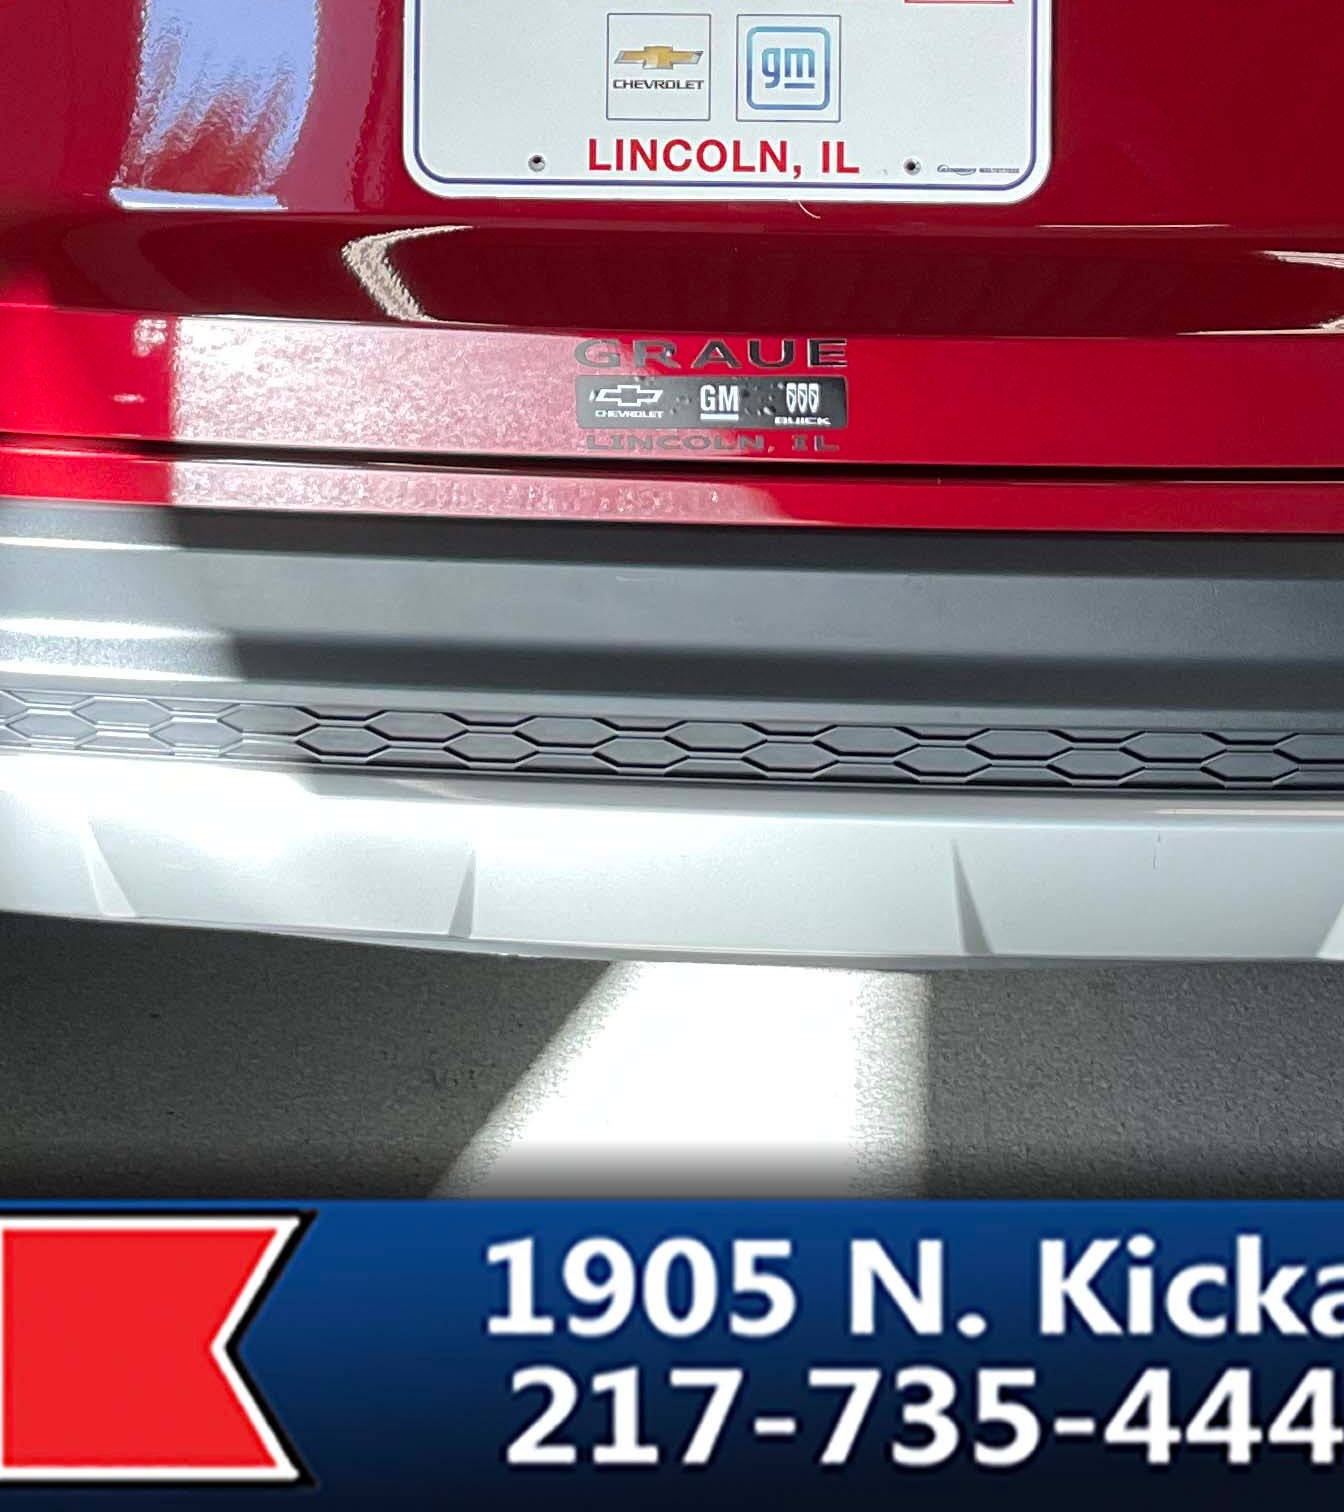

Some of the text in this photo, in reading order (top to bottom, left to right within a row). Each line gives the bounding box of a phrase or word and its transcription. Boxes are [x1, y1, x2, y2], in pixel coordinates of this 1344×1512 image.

[612, 79, 705, 90] CHEVROLET
[588, 138, 860, 177] LINCOLN, IL
[573, 338, 849, 369] GRAUE
[699, 384, 740, 413] GM
[594, 409, 665, 419] CHEVROLET
[773, 416, 832, 426] BUICK
[791, 435, 841, 452] IL
